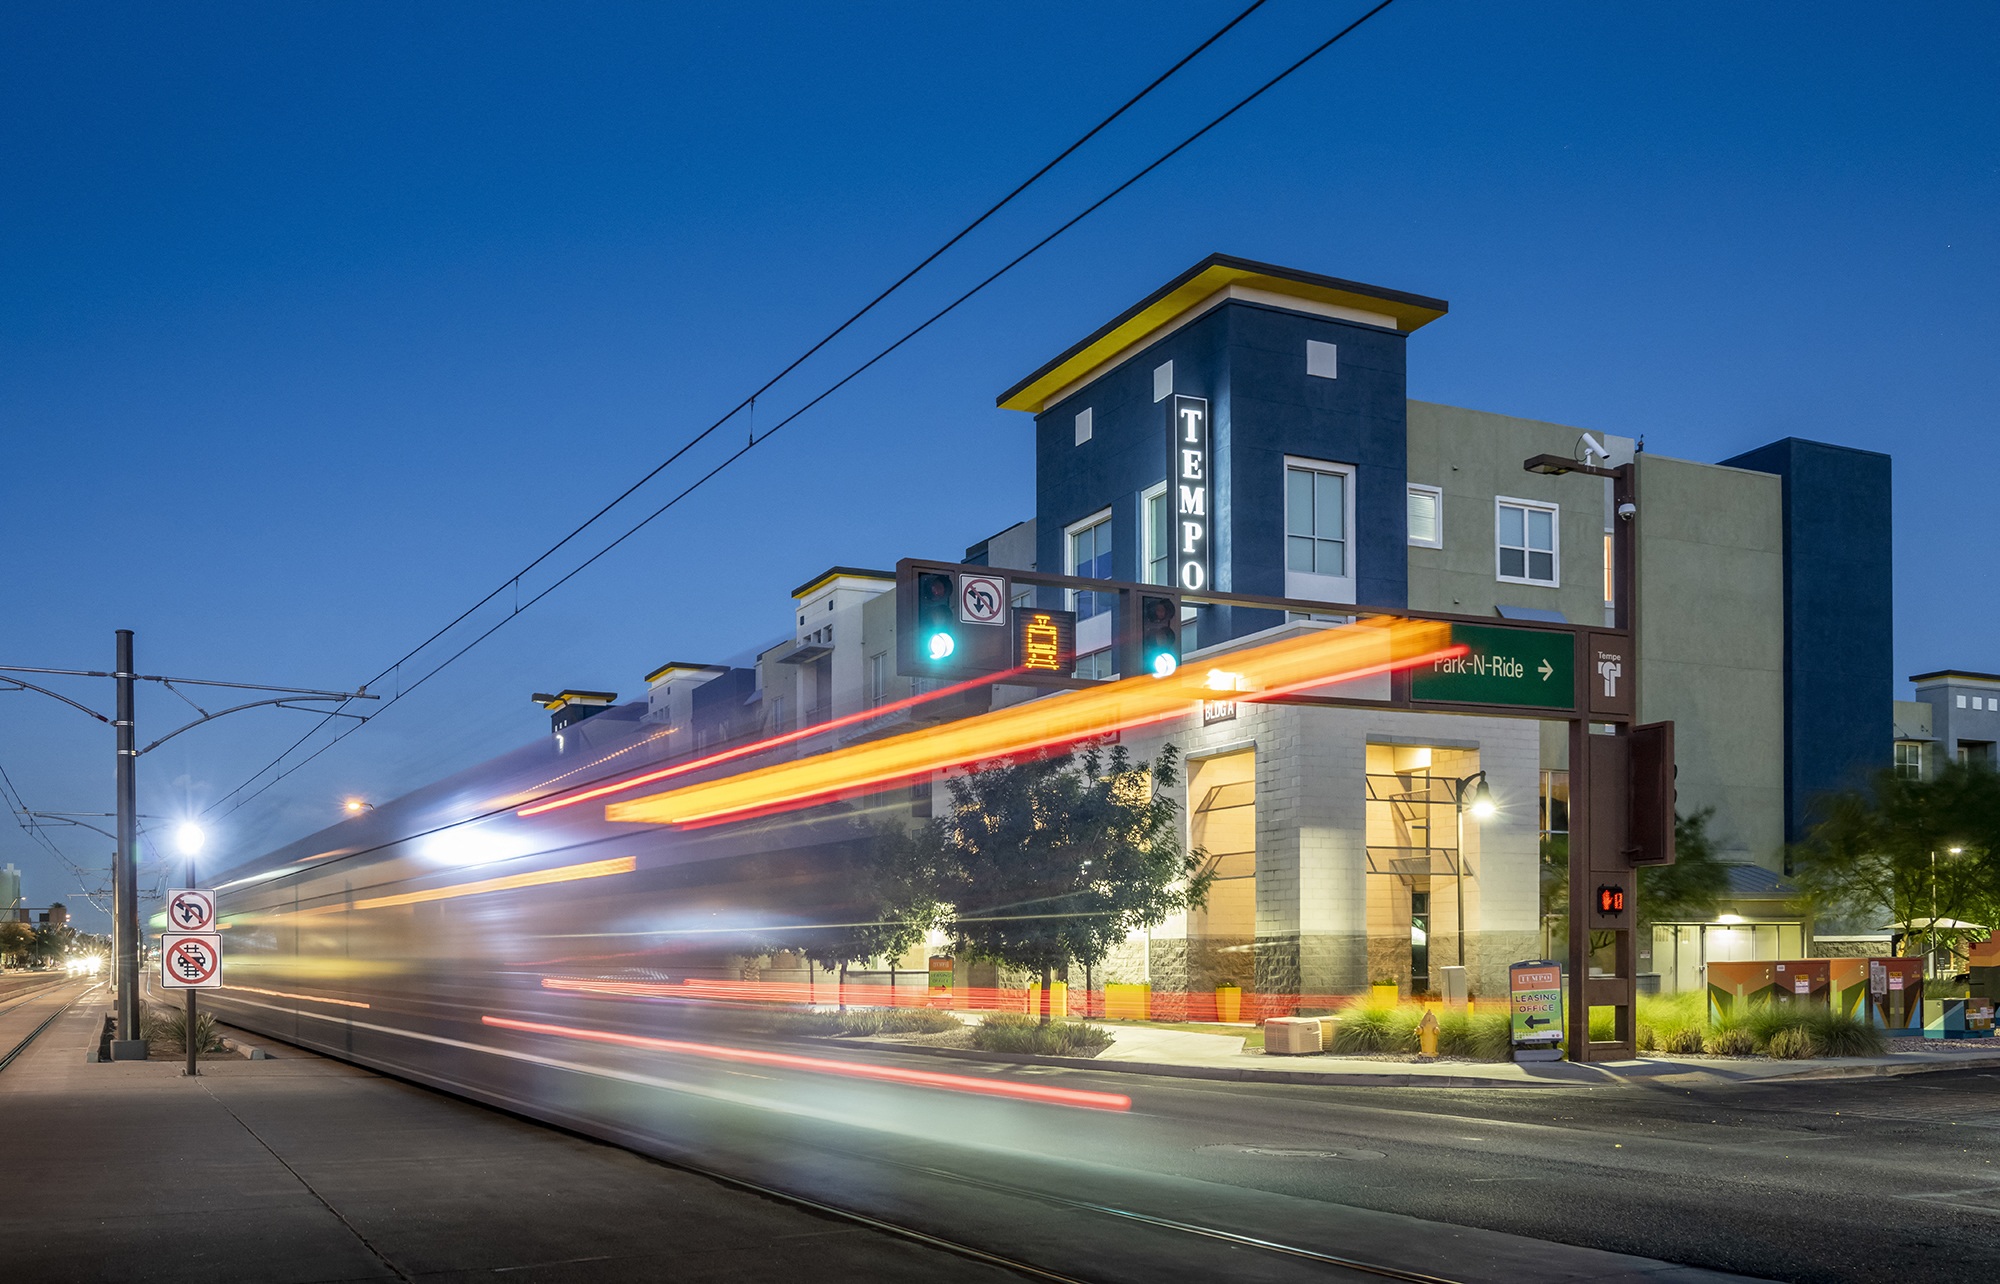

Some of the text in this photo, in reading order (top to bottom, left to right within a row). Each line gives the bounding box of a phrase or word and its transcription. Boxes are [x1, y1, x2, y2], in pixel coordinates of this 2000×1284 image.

[1180, 408, 1205, 590] TEMPO
[1598, 651, 1621, 661] Tempe
[1434, 652, 1524, 678] Park-N-Ride
[1205, 701, 1234, 720] BLDG A
[1516, 994, 1557, 1003] LEASING
[1519, 1004, 1554, 1013] OFFICE
